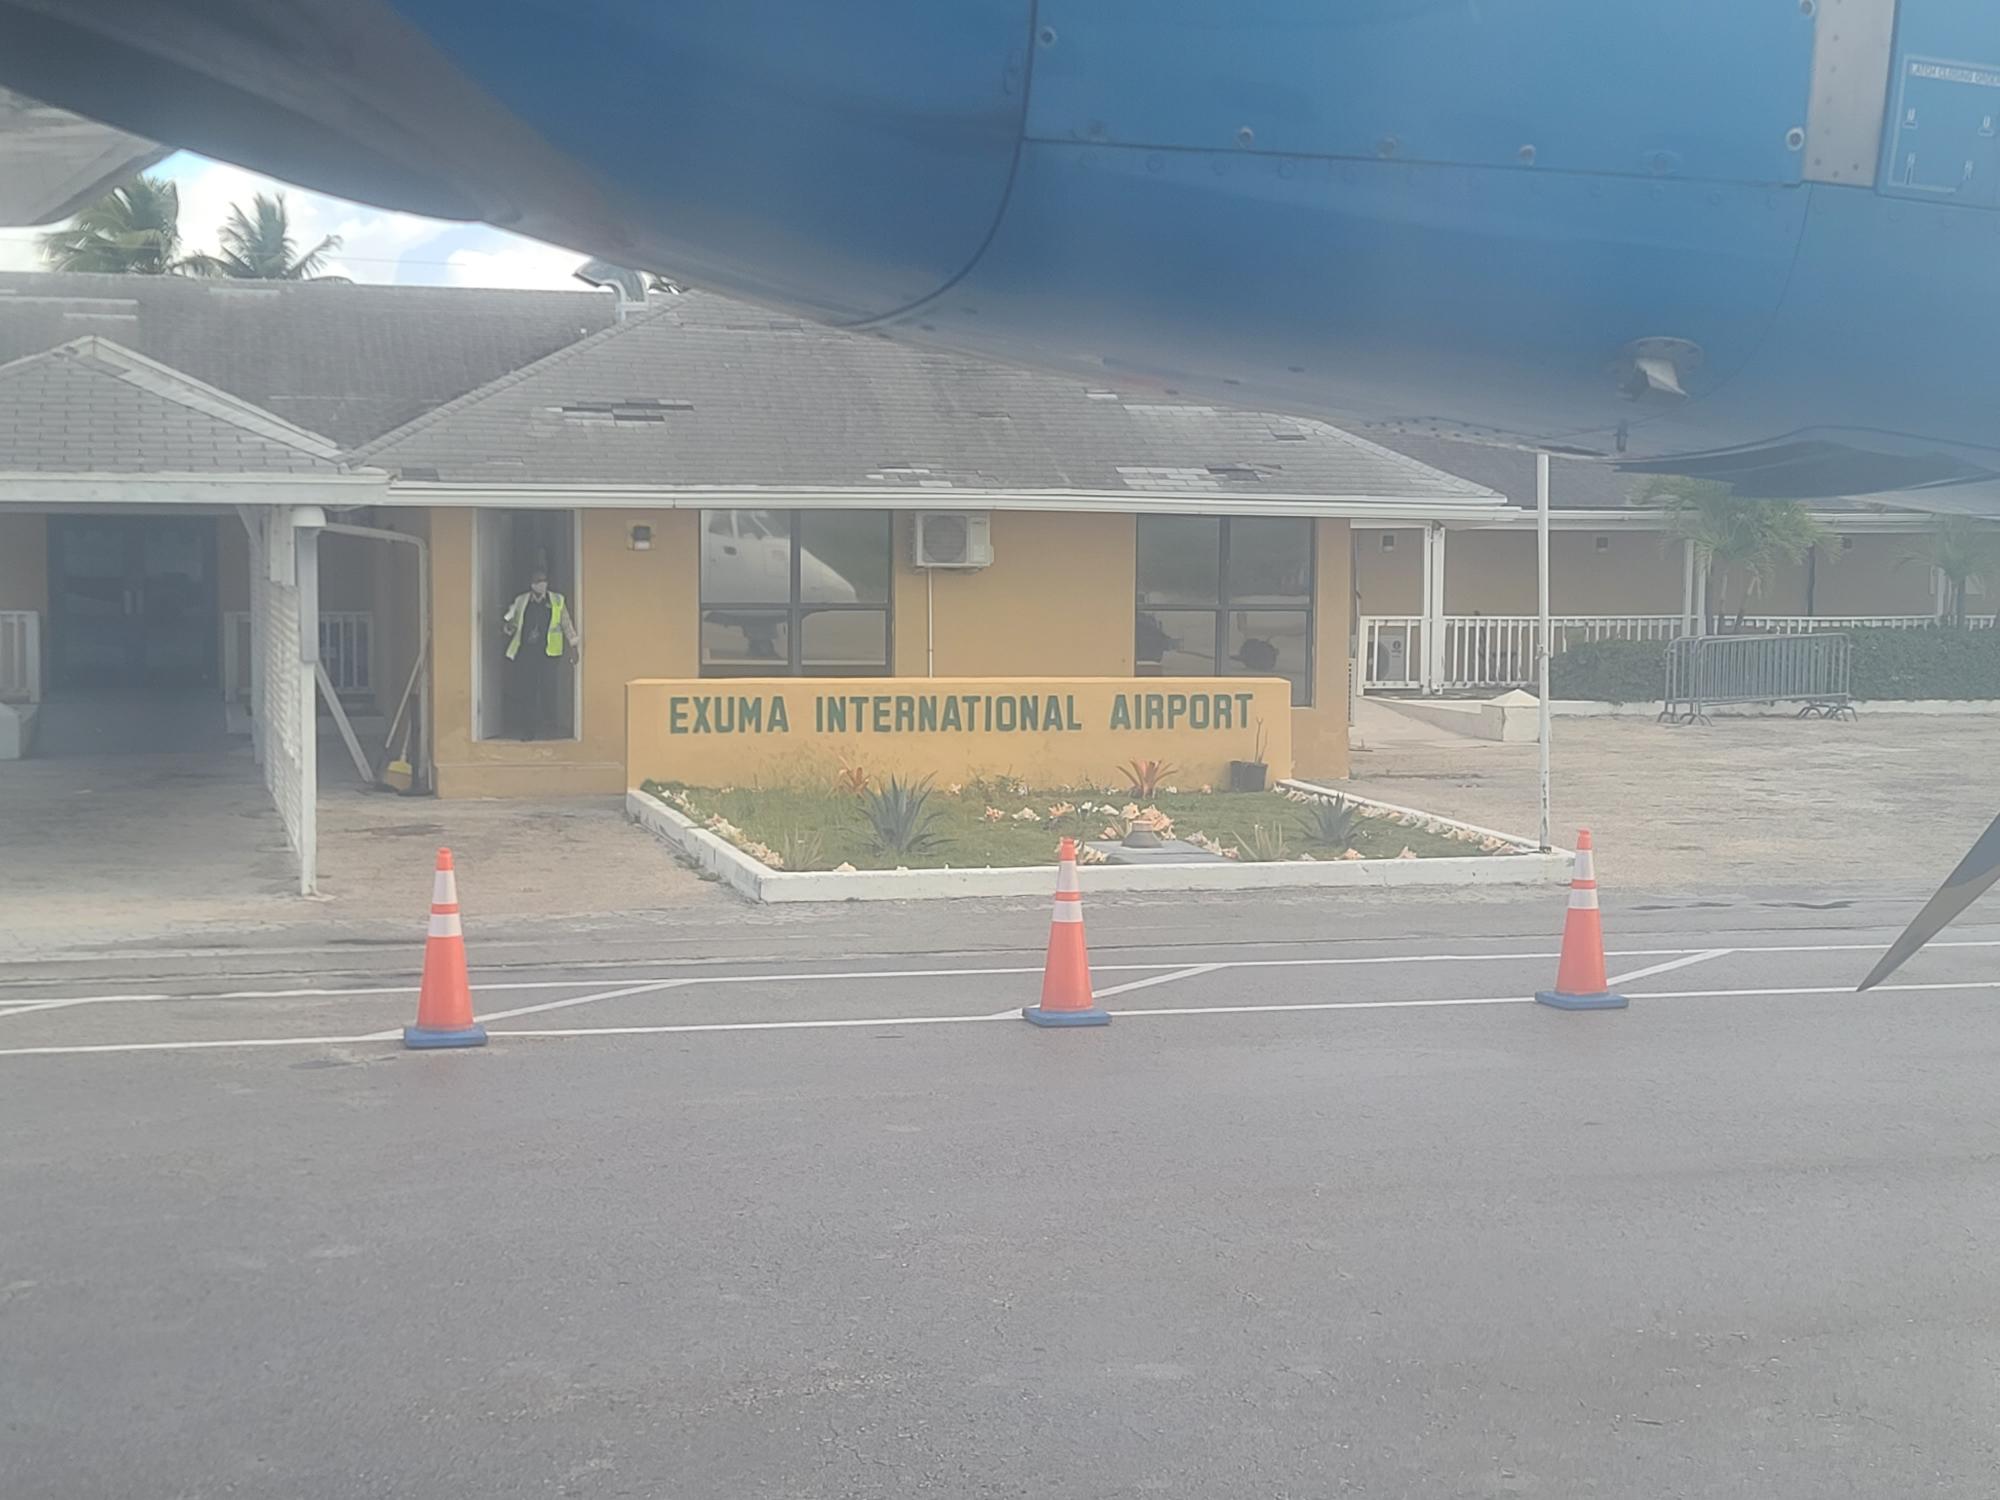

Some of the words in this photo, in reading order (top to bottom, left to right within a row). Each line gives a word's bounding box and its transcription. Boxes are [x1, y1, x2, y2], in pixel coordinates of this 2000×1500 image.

[670, 696, 789, 734] EXUMA
[815, 695, 1082, 733] INTERNATIONAL
[1109, 693, 1253, 731] AIRPORT
